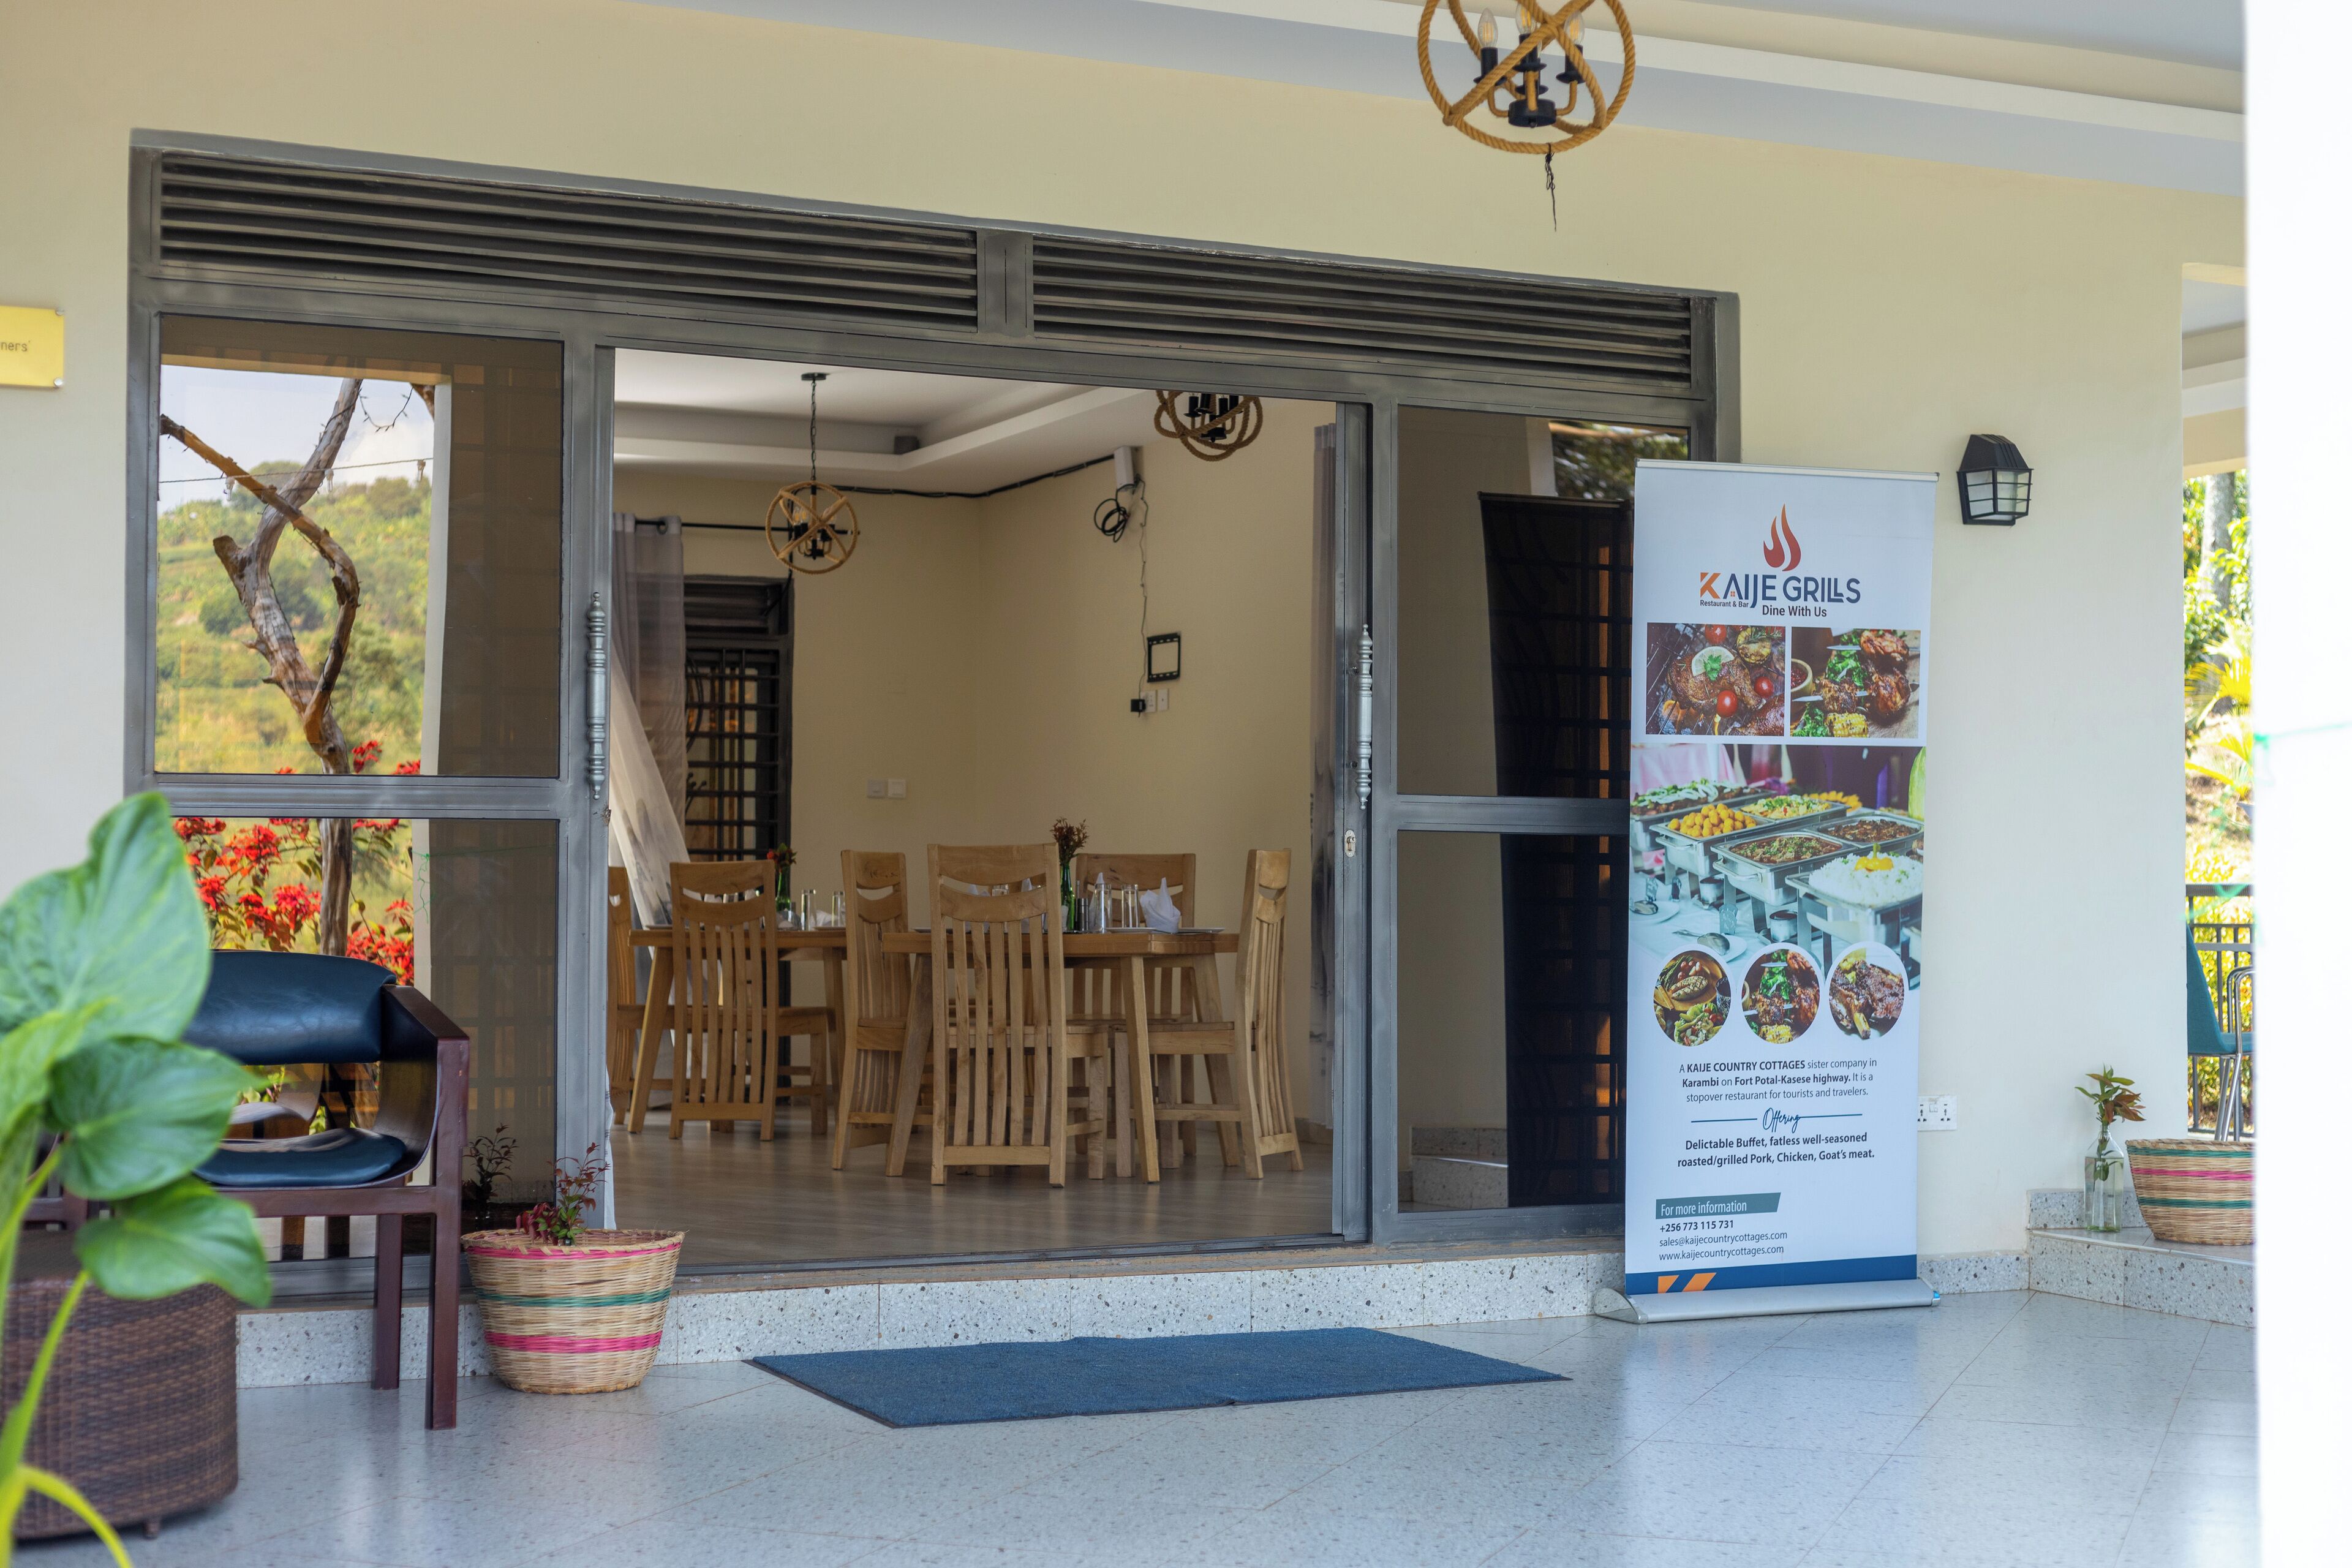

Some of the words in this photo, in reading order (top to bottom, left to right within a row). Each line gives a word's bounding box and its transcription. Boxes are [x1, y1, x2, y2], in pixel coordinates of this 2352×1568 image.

[1700, 573, 1777, 608] KAIJE
[1783, 576, 1861, 603] GRILLS
[1762, 605, 1785, 616] Dine
[1788, 606, 1811, 617] With
[1814, 607, 1827, 617] Us
[1679, 1065, 1685, 1073] A
[1687, 1063, 1711, 1072] KAIJE
[1713, 1062, 1757, 1071] COUNTRY
[1759, 1060, 1805, 1070] COTTAGES
[1807, 1060, 1828, 1069] sister
[1830, 1060, 1867, 1069] company
[1683, 1077, 1719, 1087] Karambi
[1735, 1077, 1753, 1085] Fort
[1755, 1076, 1811, 1085] Potal-Kasese
[1813, 1074, 1850, 1085] highway.
[1853, 1072, 1858, 1081] It
[1860, 1072, 1867, 1081] is
[1686, 1092, 1723, 1104] stopover
[1725, 1091, 1768, 1101] restaurant
[1770, 1090, 1781, 1099] for
[1783, 1090, 1814, 1098] tourists
[1815, 1088, 1831, 1098] and
[1833, 1087, 1868, 1096] travelers.
[1763, 1107, 1801, 1133] Offering
[1686, 1137, 1734, 1150] Delictable
[1736, 1136, 1768, 1148] Buffet,
[1770, 1135, 1800, 1146] fatless
[1803, 1133, 1867, 1145] well-seasoned
[1678, 1154, 1748, 1167] roasted/grilled
[1751, 1153, 1774, 1164] Pork,
[1777, 1152, 1817, 1163] Chicken,
[1819, 1150, 1847, 1160] Goat's
[1849, 1150, 1875, 1158] meat.
[1661, 1204, 1673, 1216] For
[1676, 1204, 1696, 1215] more
[1698, 1200, 1747, 1213] information
[1660, 1223, 1681, 1232] +256
[1683, 1222, 1698, 1231] 773
[1701, 1221, 1716, 1229] 115
[1719, 1220, 1733, 1229] 731
[1659, 1232, 1787, 1246] sales@kaijecountrycottages.com
[1659, 1246, 1784, 1261] www.kaijecountrycottages.com
